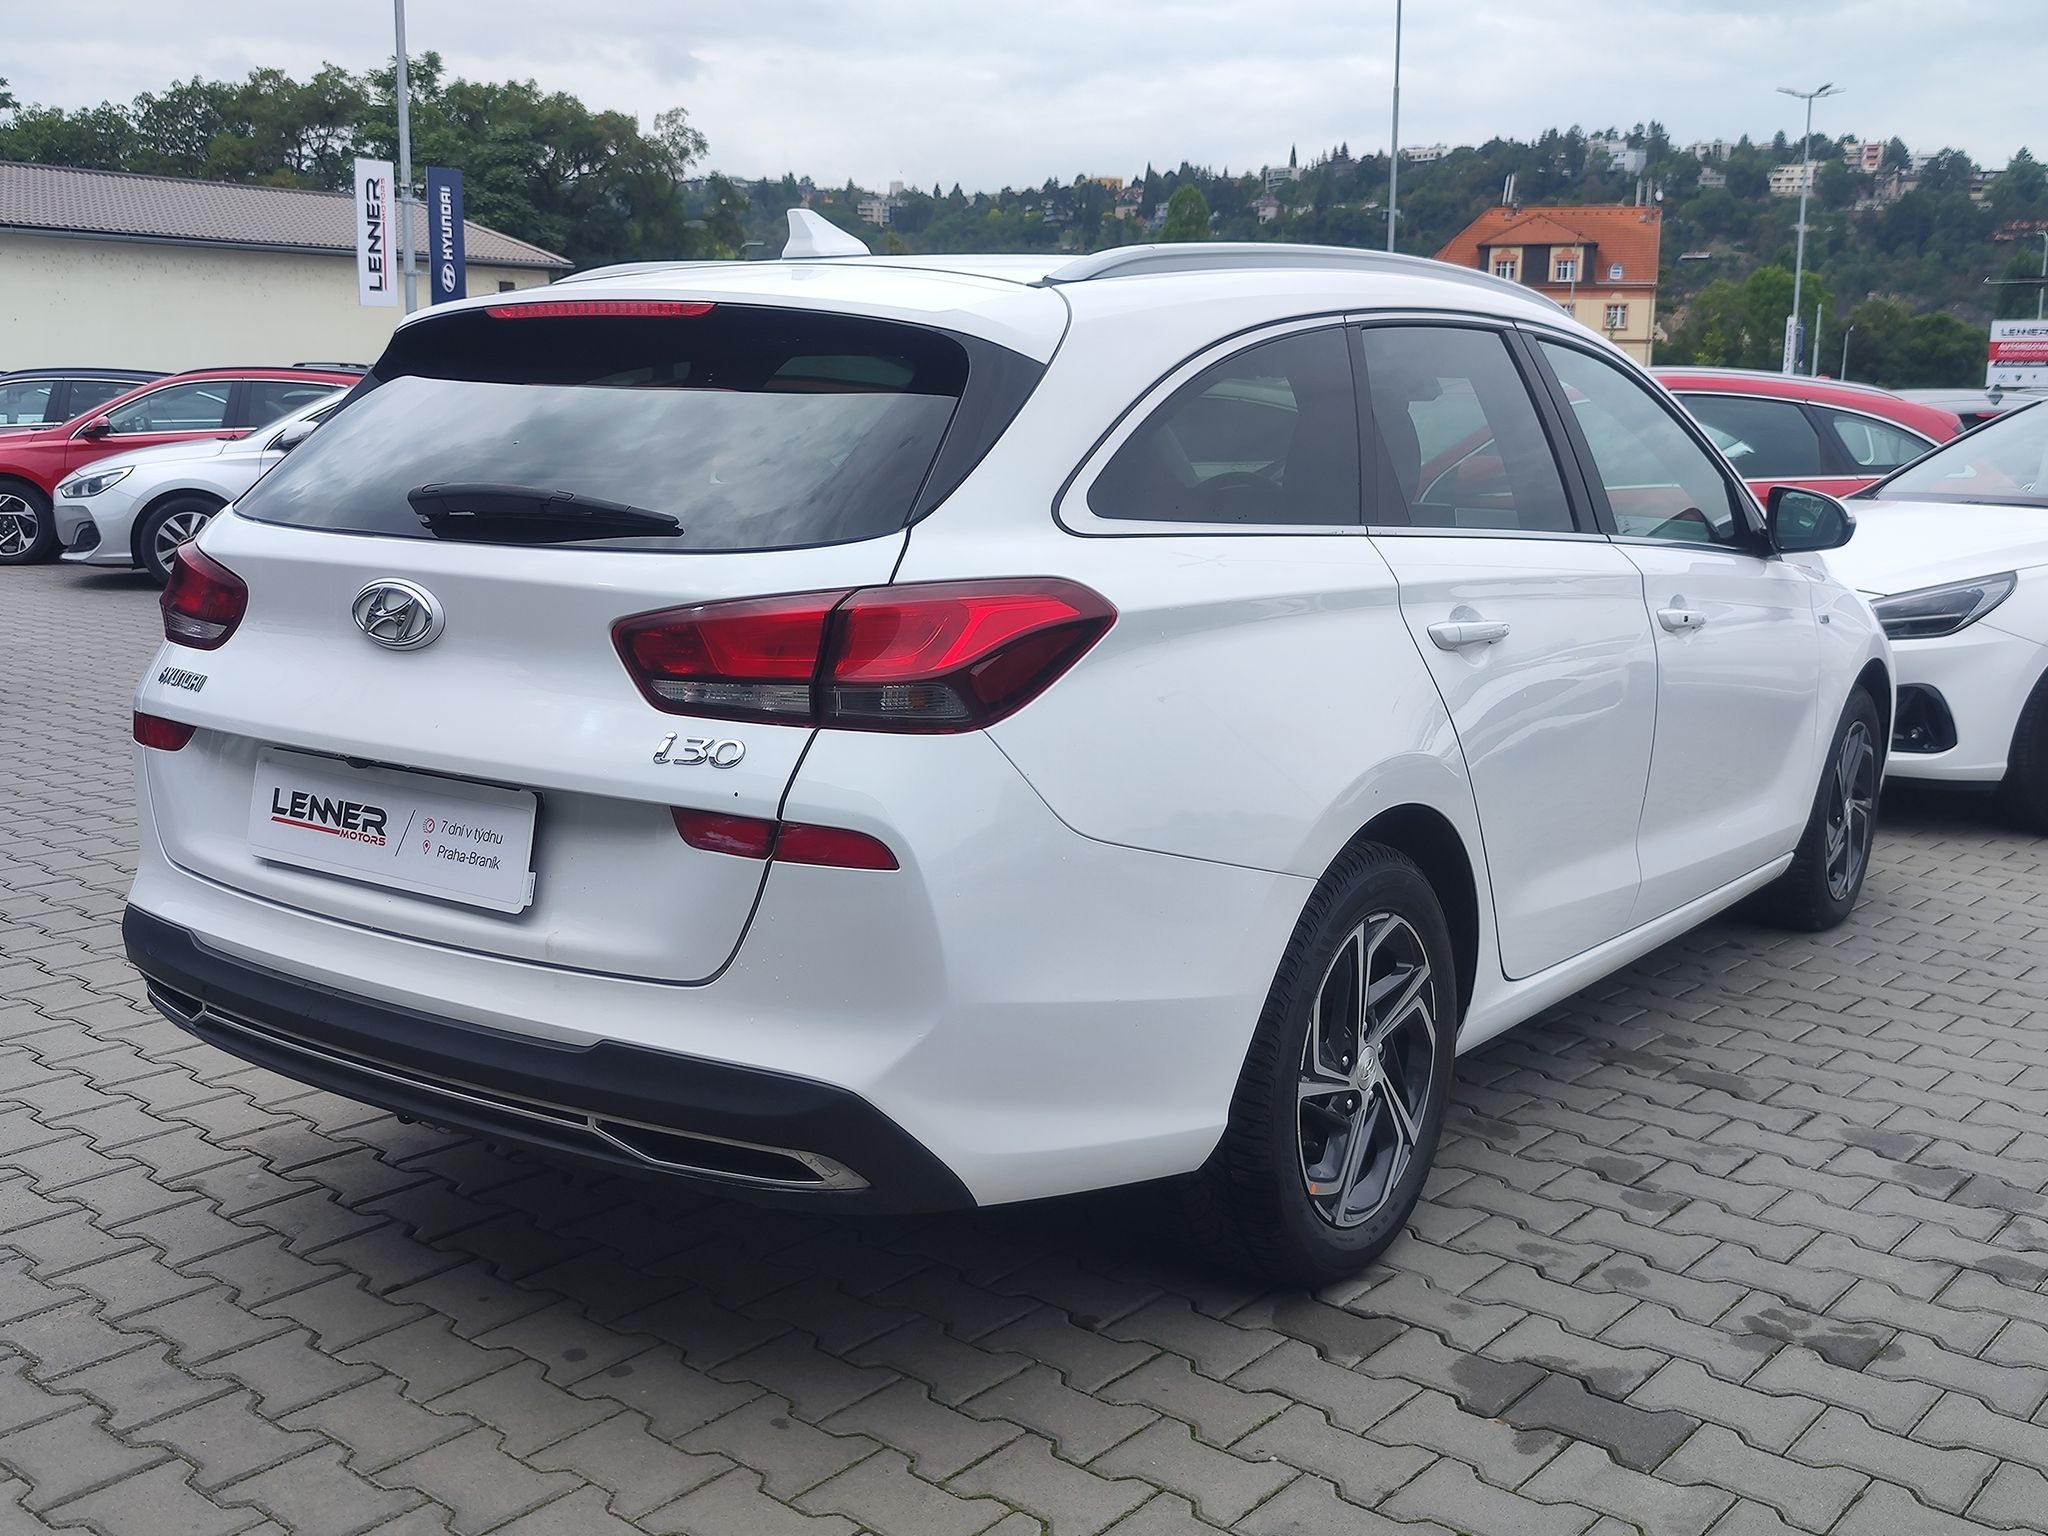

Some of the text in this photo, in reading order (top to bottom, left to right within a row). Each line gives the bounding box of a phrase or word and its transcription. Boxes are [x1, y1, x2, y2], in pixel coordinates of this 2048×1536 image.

[366, 178, 383, 291] LENNER
[440, 186, 454, 260] HYUNDAI
[158, 666, 208, 693] HYUNDAI
[653, 731, 746, 770] i30
[271, 787, 388, 837] LENNER
[339, 829, 387, 847] MOTORS
[440, 820, 504, 845] 7 dní v týdnu
[437, 844, 501, 871] Praha-Braník
